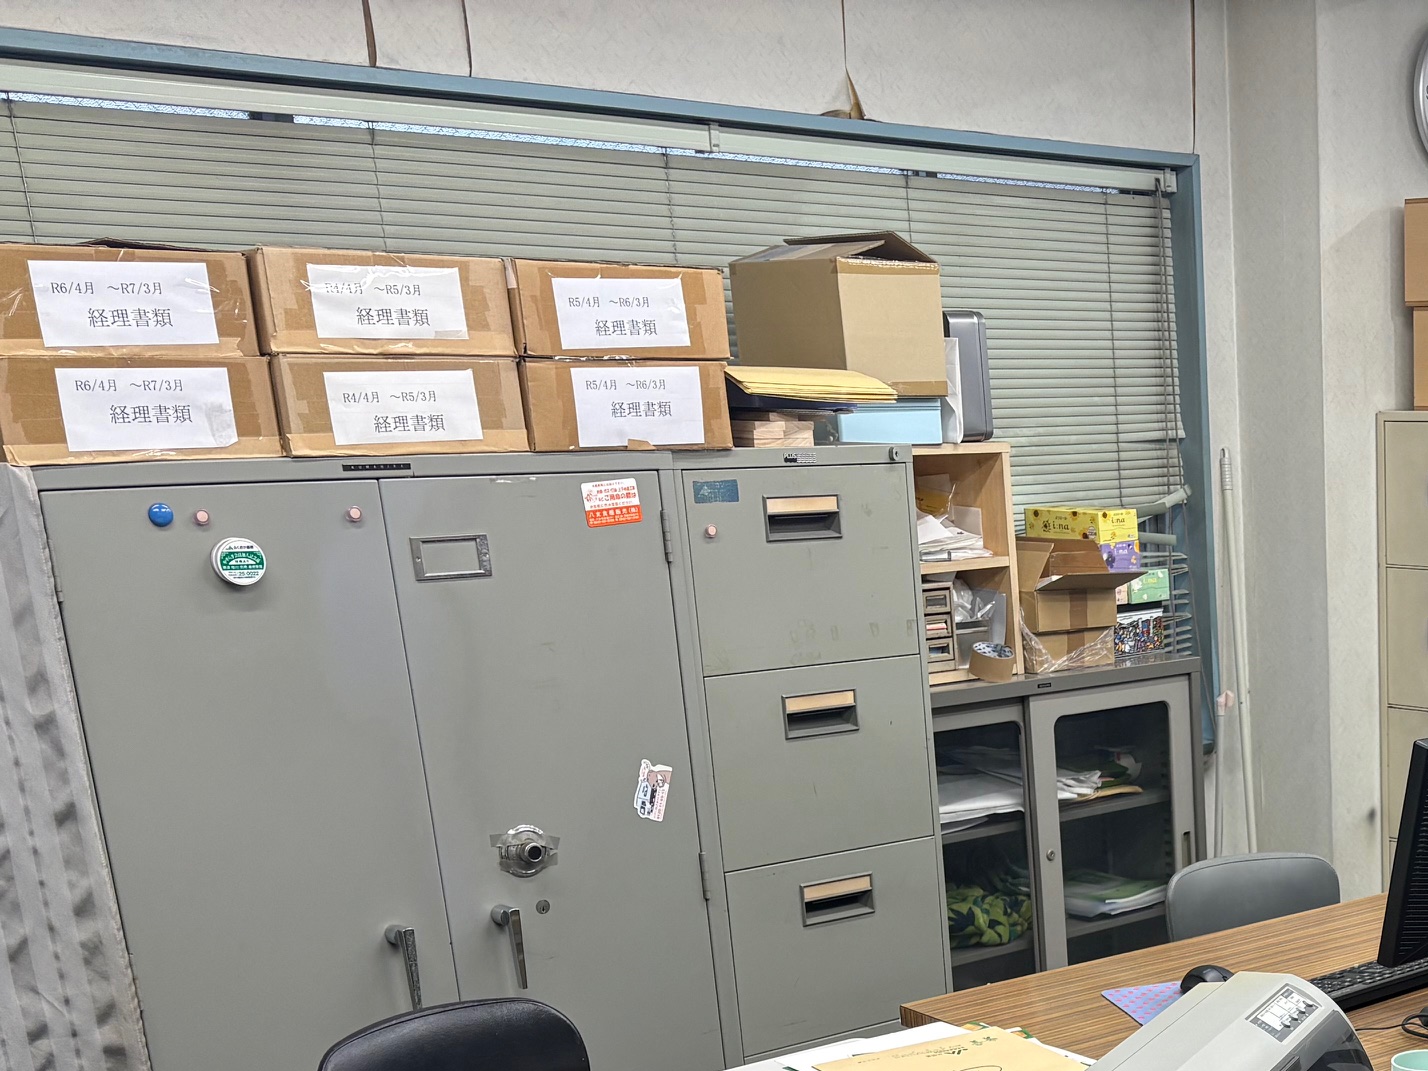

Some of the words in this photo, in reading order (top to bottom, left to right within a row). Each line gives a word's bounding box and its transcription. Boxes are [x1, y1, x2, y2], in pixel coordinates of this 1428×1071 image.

[51, 281, 95, 296] R6/4月
[568, 296, 601, 309] R5/4月
[88, 308, 173, 329] 経理書類
[356, 308, 431, 327] 経理書類
[595, 319, 658, 337] 経理書類
[75, 378, 118, 392] R6/4月
[586, 379, 618, 391] R5/4月
[342, 390, 380, 404] R4/4月
[109, 405, 193, 425] 経理書類
[611, 401, 672, 419] 経理書類
[373, 415, 446, 434] 経理書類
